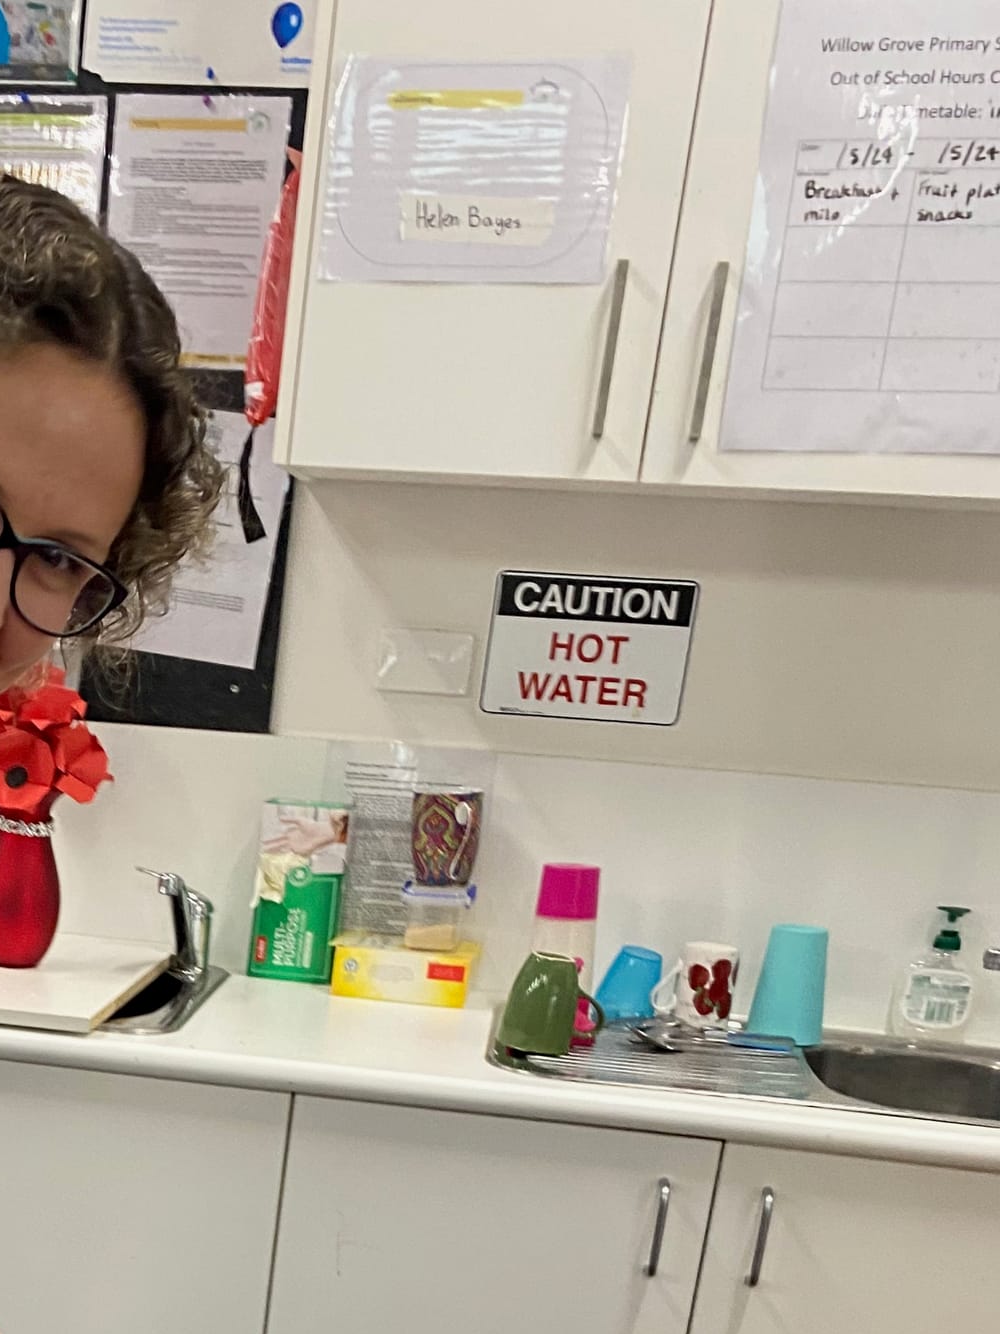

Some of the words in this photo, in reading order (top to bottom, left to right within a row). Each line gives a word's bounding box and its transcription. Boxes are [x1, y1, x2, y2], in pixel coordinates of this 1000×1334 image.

[820, 37, 875, 52] Willow
[878, 37, 924, 52] Grove
[929, 36, 991, 54] Primary
[830, 71, 859, 86] Out
[863, 70, 880, 85] of
[884, 69, 935, 85] School
[940, 71, 985, 85] Hours
[918, 179, 958, 199] Fruit
[414, 199, 461, 230] Helen
[513, 581, 680, 621] CAUTION
[548, 631, 630, 665] HOT
[517, 671, 648, 709] WATER
